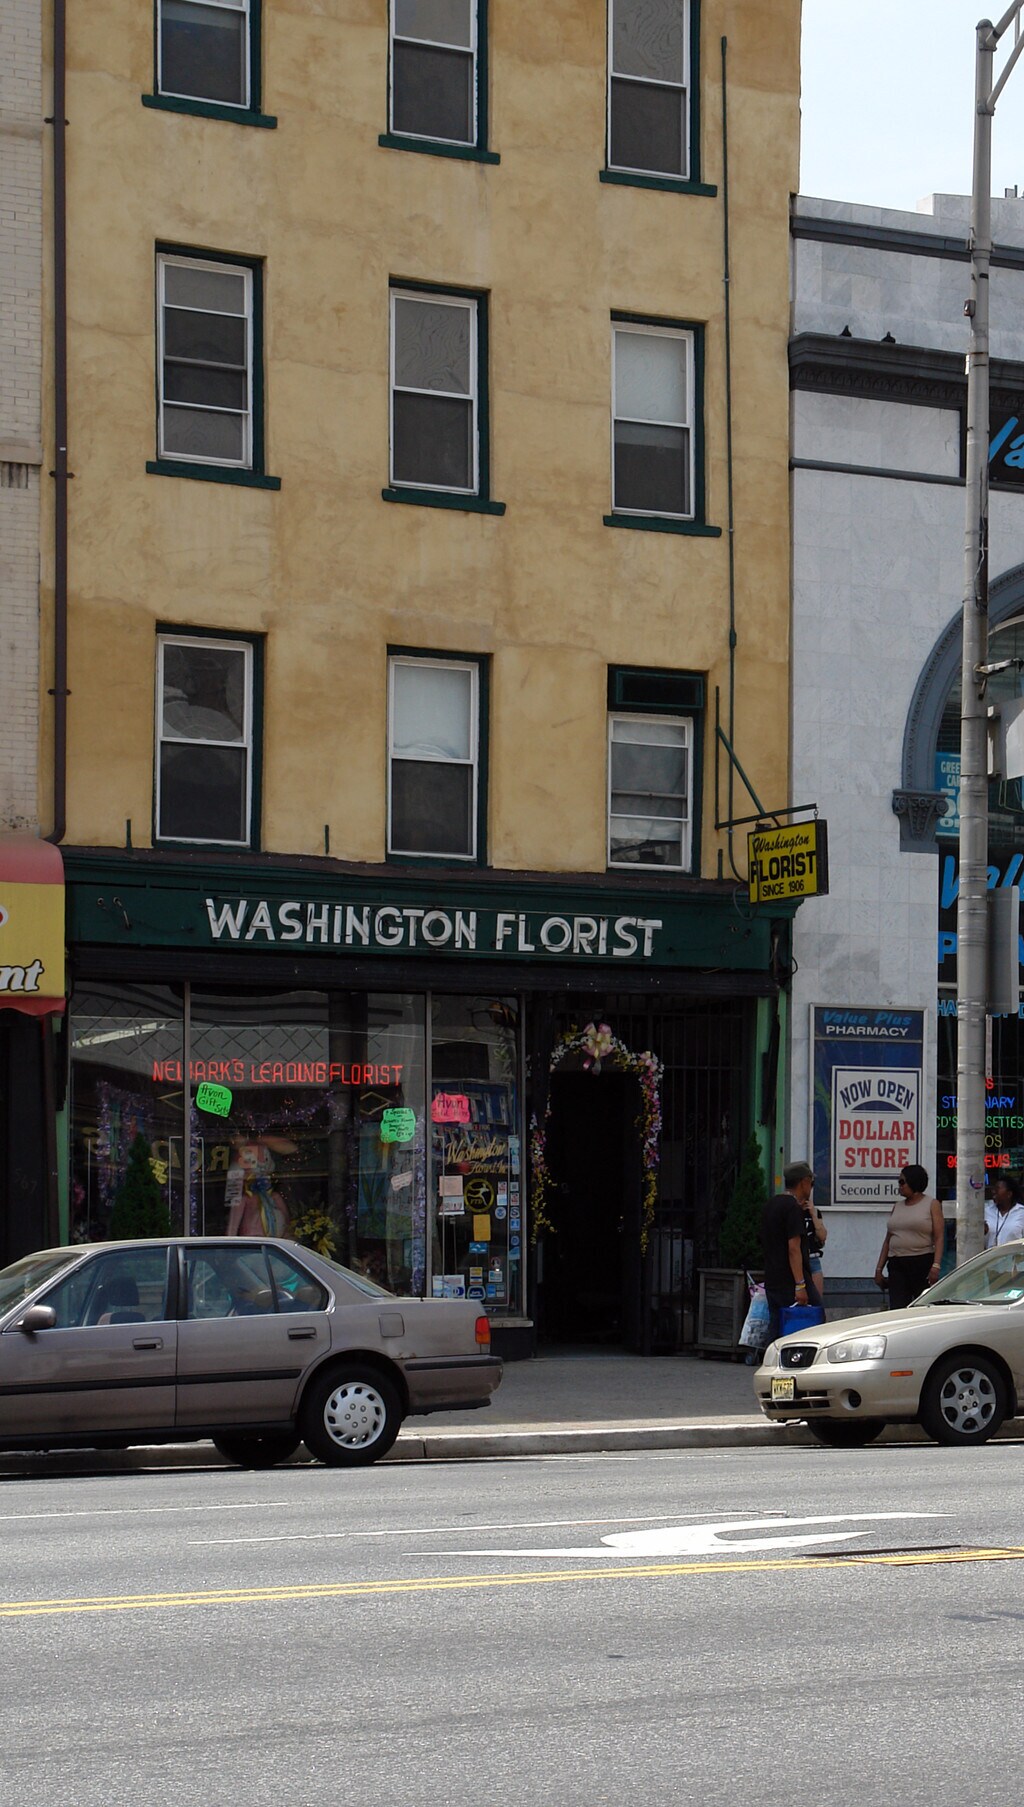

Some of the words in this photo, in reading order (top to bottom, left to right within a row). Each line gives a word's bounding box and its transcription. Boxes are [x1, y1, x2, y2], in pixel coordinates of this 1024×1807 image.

[754, 833, 810, 854] Washington
[751, 850, 816, 884] FLORIST
[762, 882, 785, 897] SINCE
[788, 879, 805, 893] 1906
[205, 898, 477, 950] WASHINGTON
[495, 912, 663, 957] FLORIST
[822, 1010, 869, 1026] Value
[874, 1011, 912, 1026] Plus
[825, 1025, 909, 1037] PHARMACY
[251, 1062, 327, 1084] LEADING
[329, 1063, 403, 1087] FLORIST
[200, 1083, 227, 1100] Avon
[437, 1092, 464, 1110] Avon
[839, 1079, 872, 1109] NOW
[877, 1079, 915, 1111] OPEN
[839, 1119, 915, 1142] DOLLAR
[446, 1135, 506, 1165] Washington
[844, 1146, 910, 1169] STORE
[840, 1183, 882, 1197] Second
